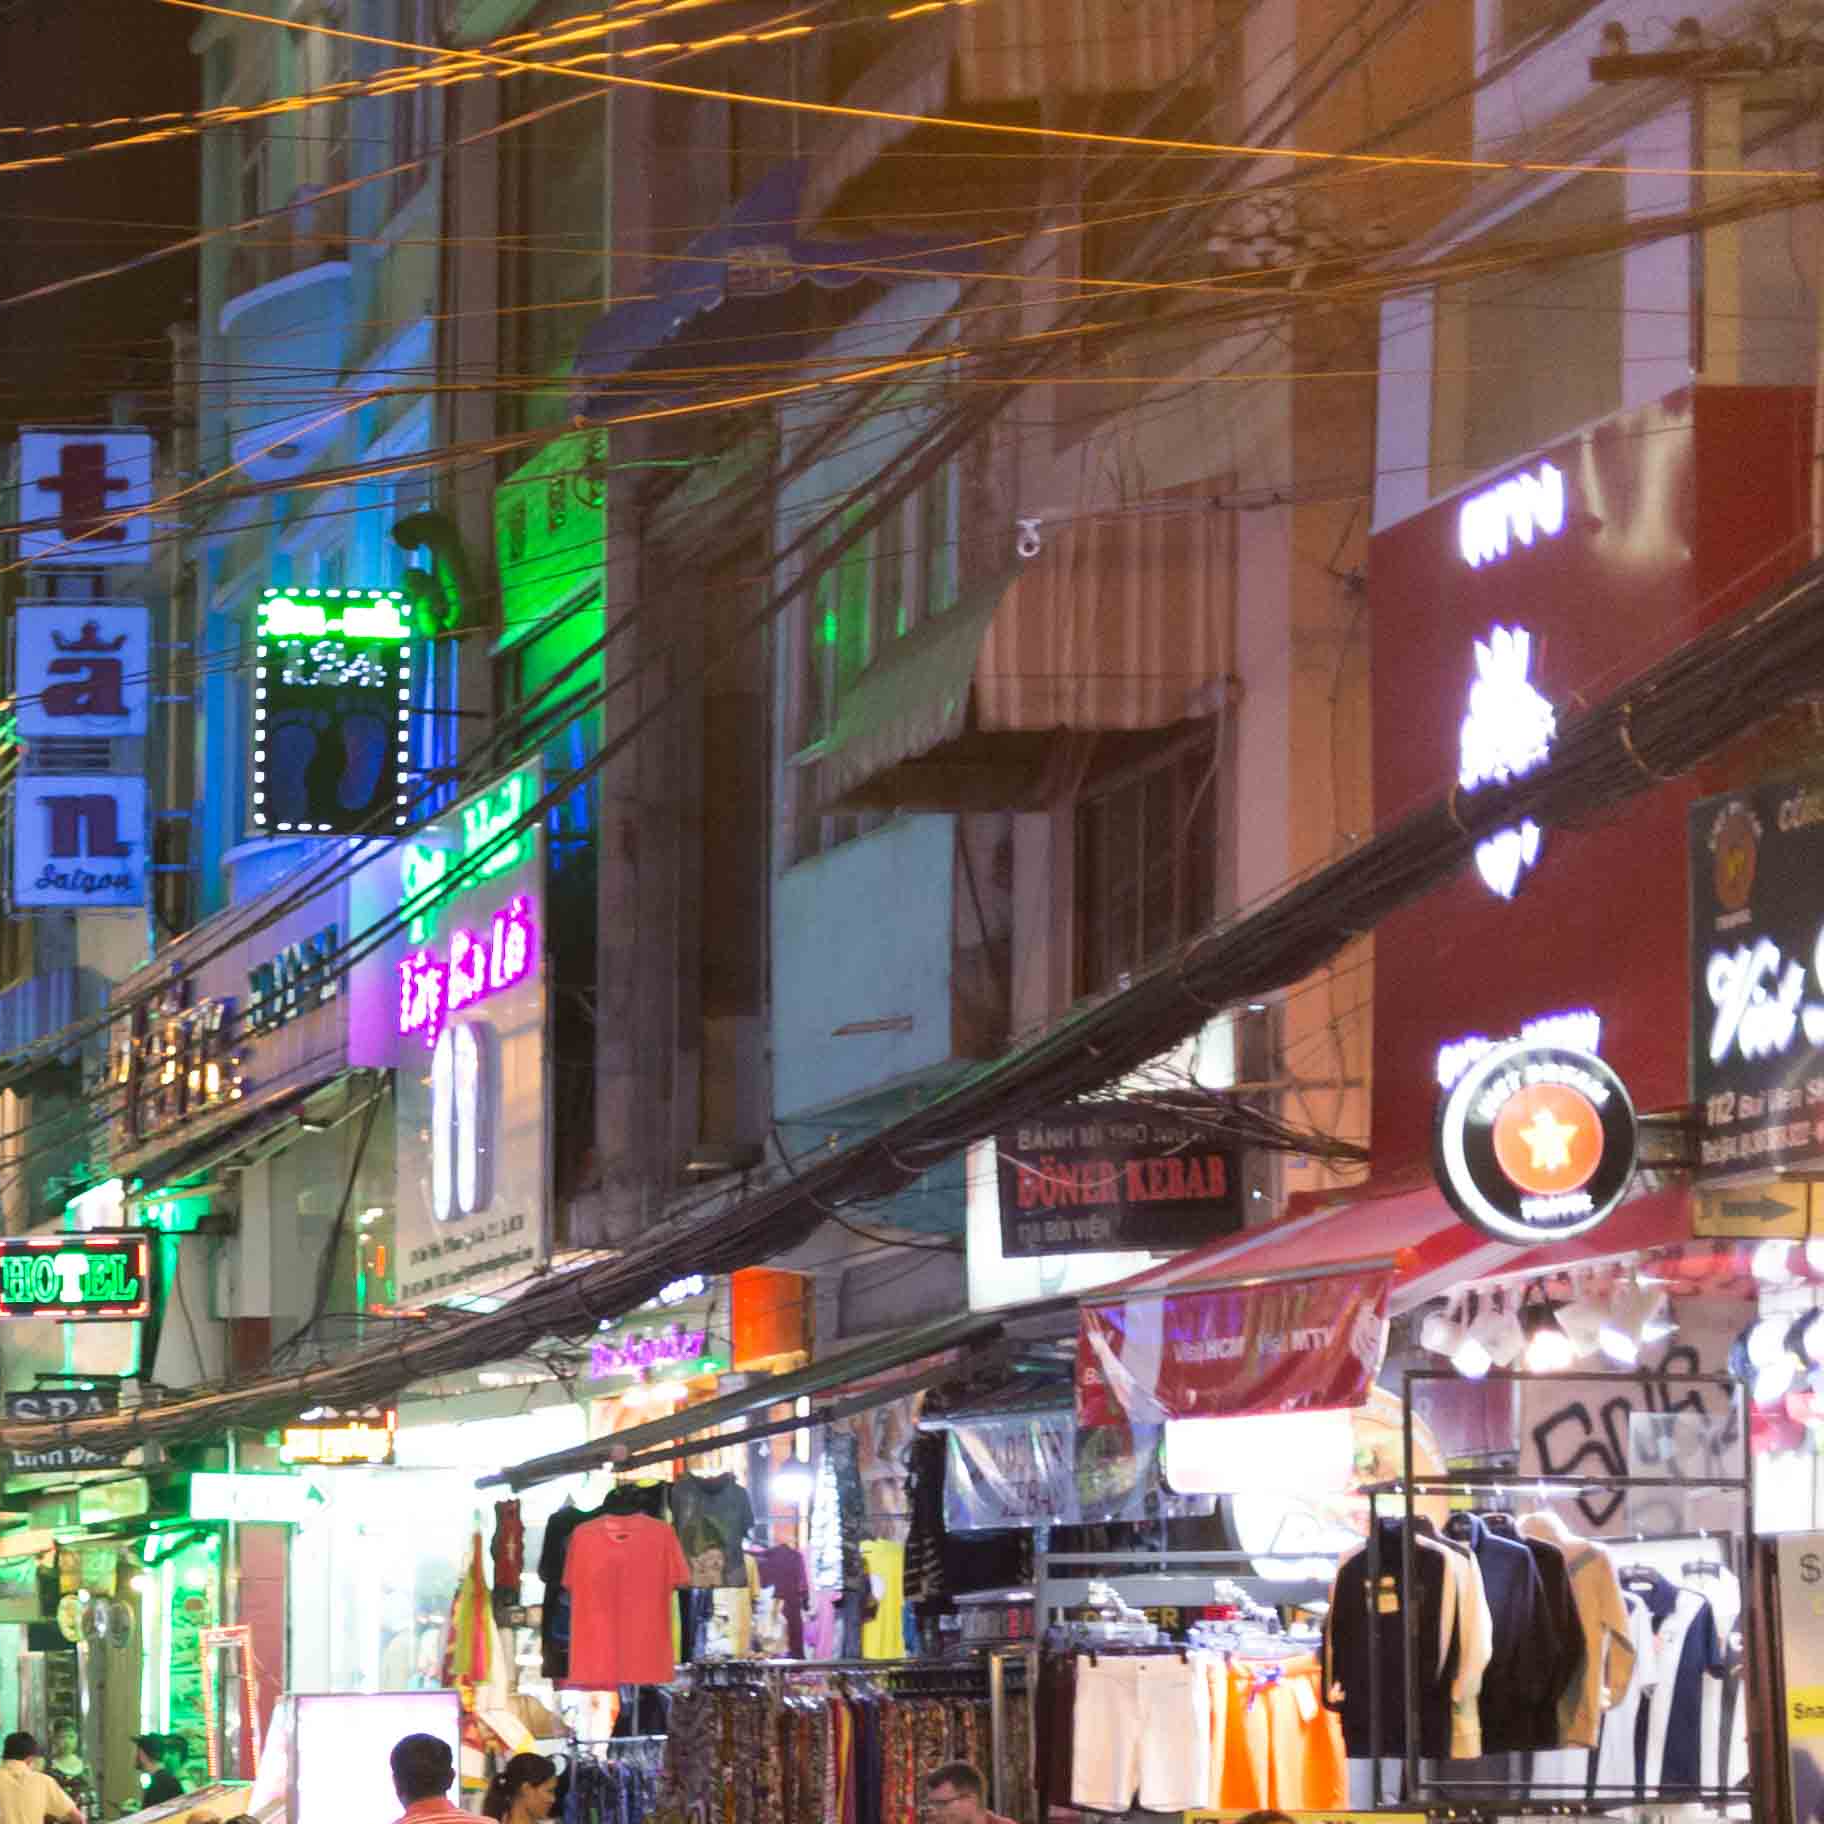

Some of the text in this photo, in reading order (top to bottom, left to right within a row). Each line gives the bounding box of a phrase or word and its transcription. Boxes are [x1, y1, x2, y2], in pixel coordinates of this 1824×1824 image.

[1017, 1155, 1227, 1208] DÖNER KEBAB
[0, 1254, 139, 1303] HOTEL
